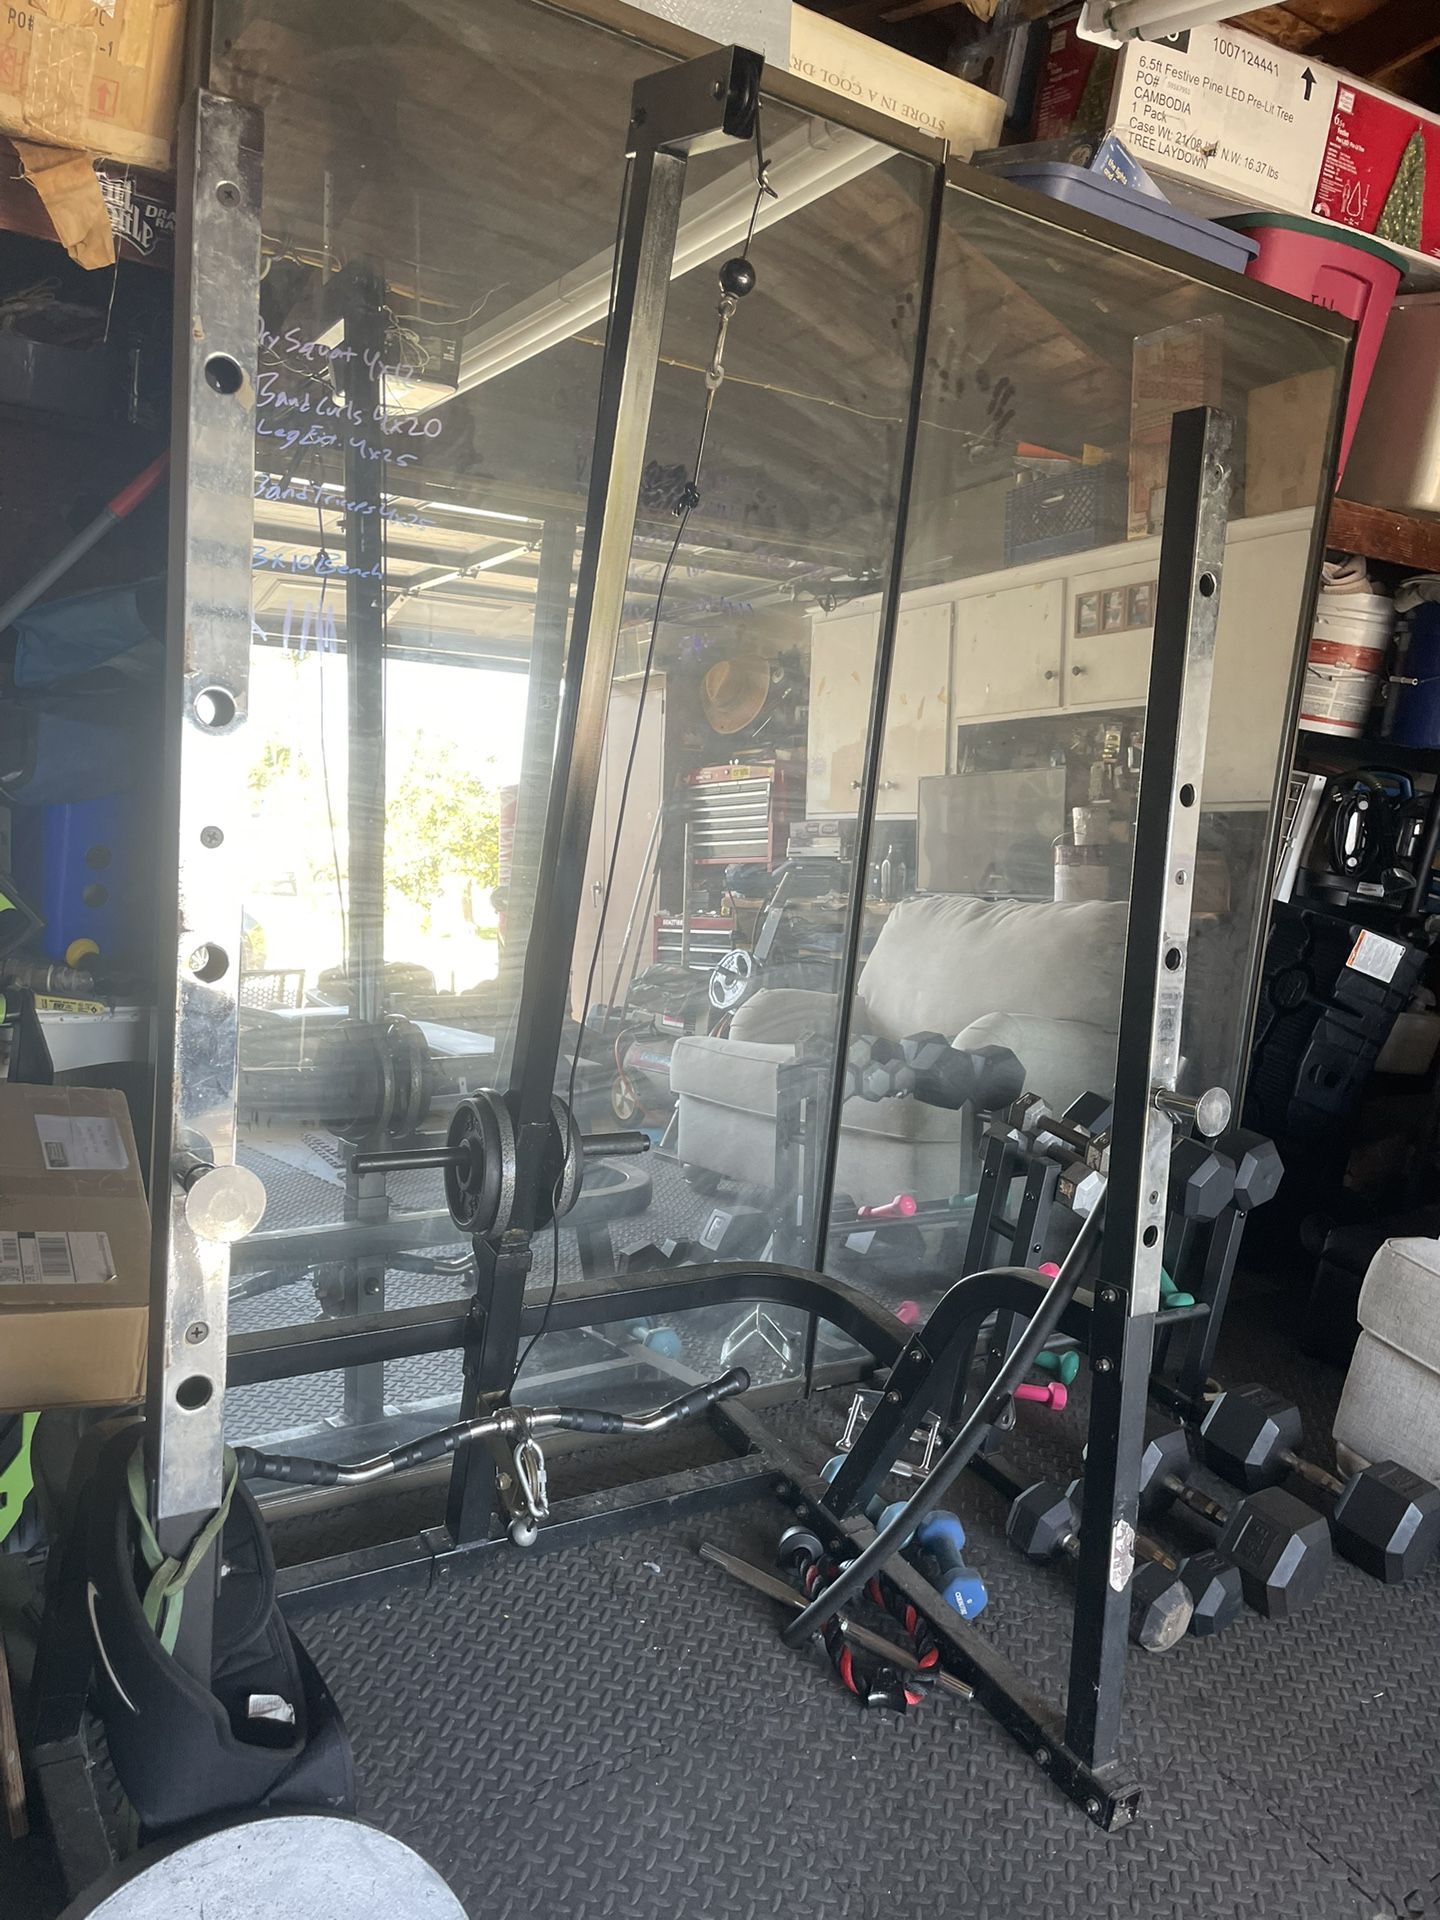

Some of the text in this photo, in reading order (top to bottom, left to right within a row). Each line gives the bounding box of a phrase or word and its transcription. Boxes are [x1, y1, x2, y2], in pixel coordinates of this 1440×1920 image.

[1213, 37, 1279, 77] 1007124441
[789, 56, 946, 131] STORE IN A COOL DR
[1136, 70, 1160, 88] PO#
[1139, 55, 1162, 73] 6.5ft
[1164, 63, 1200, 86] Festive
[1202, 76, 1223, 94] Pine
[1225, 84, 1246, 102] LED
[1247, 93, 1275, 115] Pre-Lit
[1277, 105, 1294, 123] Tree
[1132, 101, 1167, 123] 1 Pack
[1134, 86, 1191, 115] CAMBODIA
[1128, 131, 1156, 151] TREE
[1157, 141, 1209, 169] LAYDOWN
[1129, 116, 1155, 135] Case
[1157, 125, 1173, 141] Wt:
[1244, 157, 1267, 174] 16.37
[1267, 165, 1279, 180] lbs
[316, 397, 363, 426] Curls
[257, 418, 300, 450] Leg
[314, 553, 385, 580] Bench
